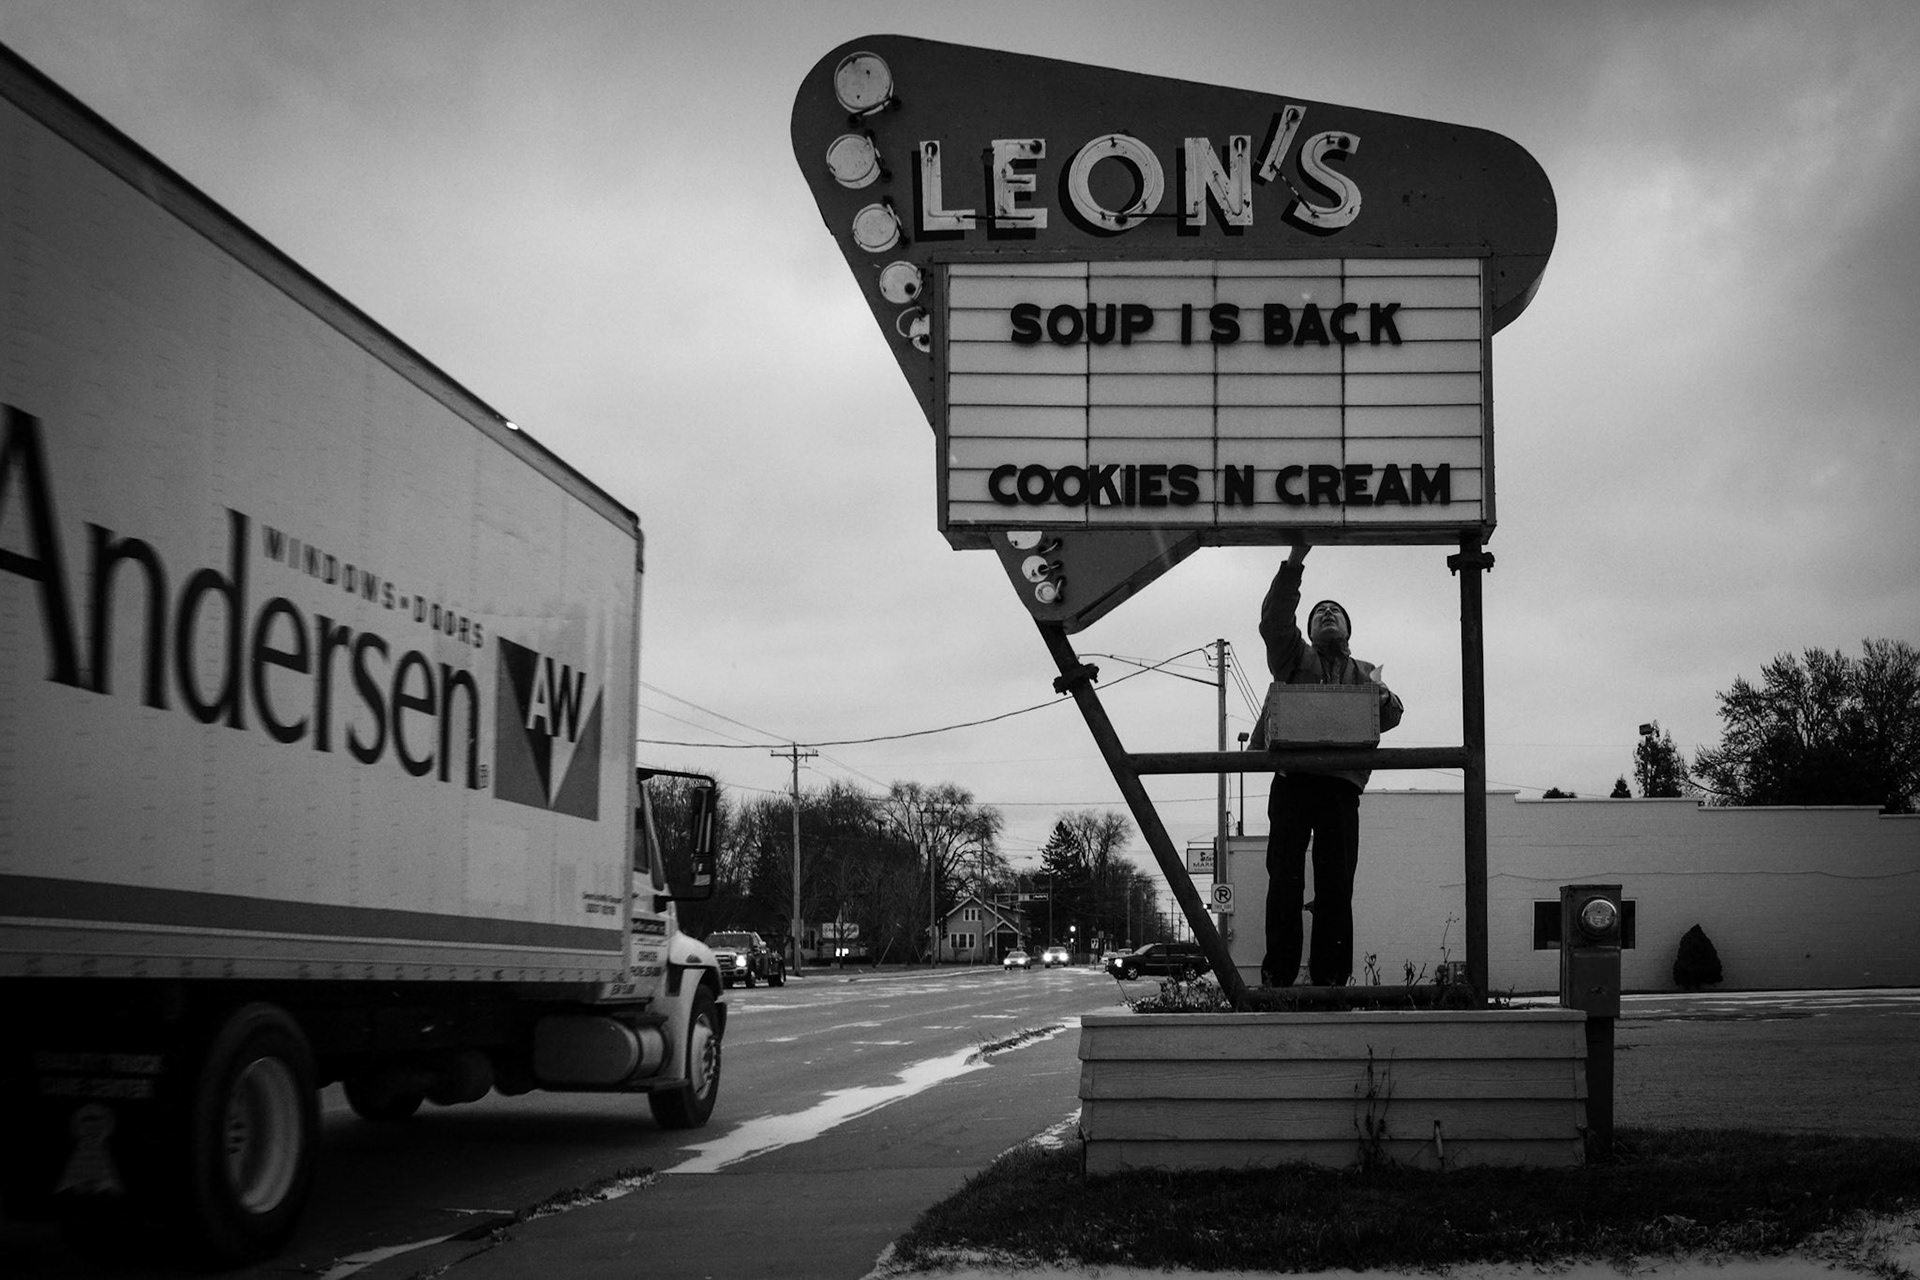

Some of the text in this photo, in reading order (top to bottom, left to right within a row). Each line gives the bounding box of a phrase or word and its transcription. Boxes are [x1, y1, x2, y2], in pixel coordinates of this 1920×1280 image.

[918, 104, 1362, 232] LEON'S
[1010, 302, 1402, 346] SOUP IS BACK
[988, 463, 1451, 507] COOKIES N CREAM
